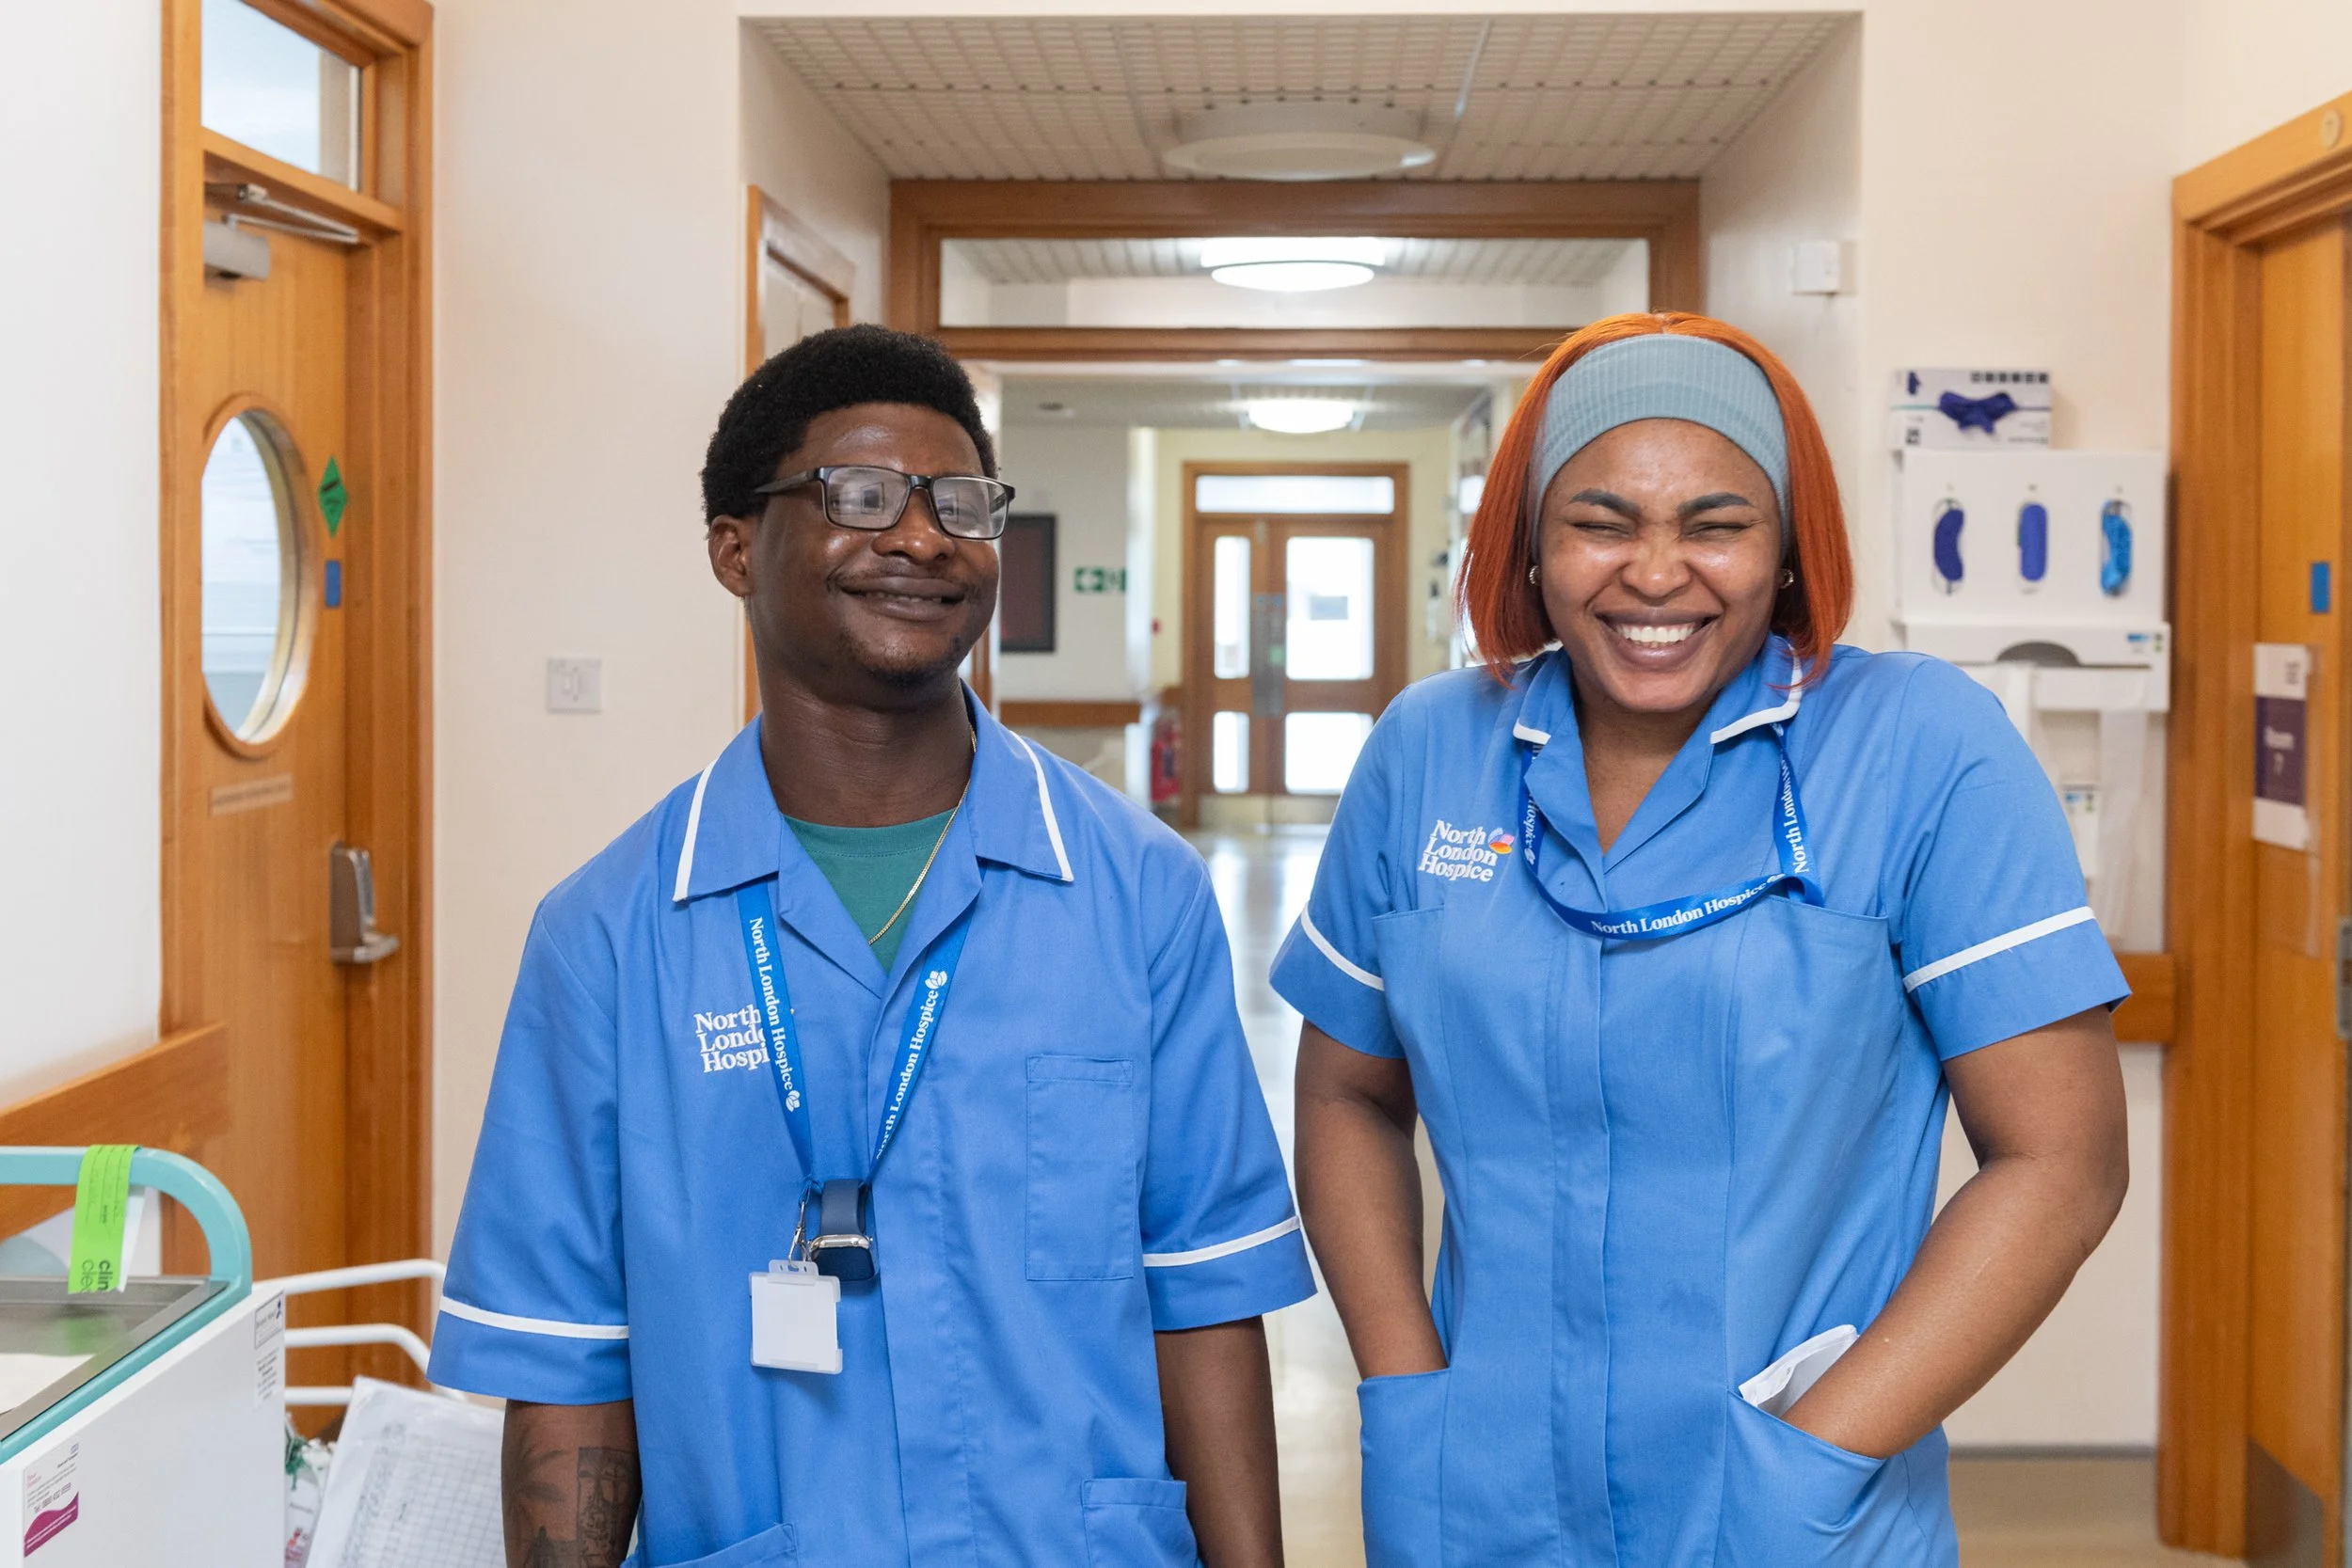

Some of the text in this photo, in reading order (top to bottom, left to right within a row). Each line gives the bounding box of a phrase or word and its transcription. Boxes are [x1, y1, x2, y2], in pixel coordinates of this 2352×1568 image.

[1430, 819, 1486, 845] North
[1423, 836, 1498, 866] London
[1786, 827, 1810, 874] North
[1417, 853, 1494, 882] Hospice
[1591, 881, 1767, 935] North London Hospice
[693, 1004, 761, 1034] North
[749, 916, 794, 1091] North London Hospice
[697, 1023, 766, 1053] Lond
[889, 1050, 919, 1113] London
[910, 988, 939, 1053] Hospice
[701, 1041, 771, 1073] Hospi
